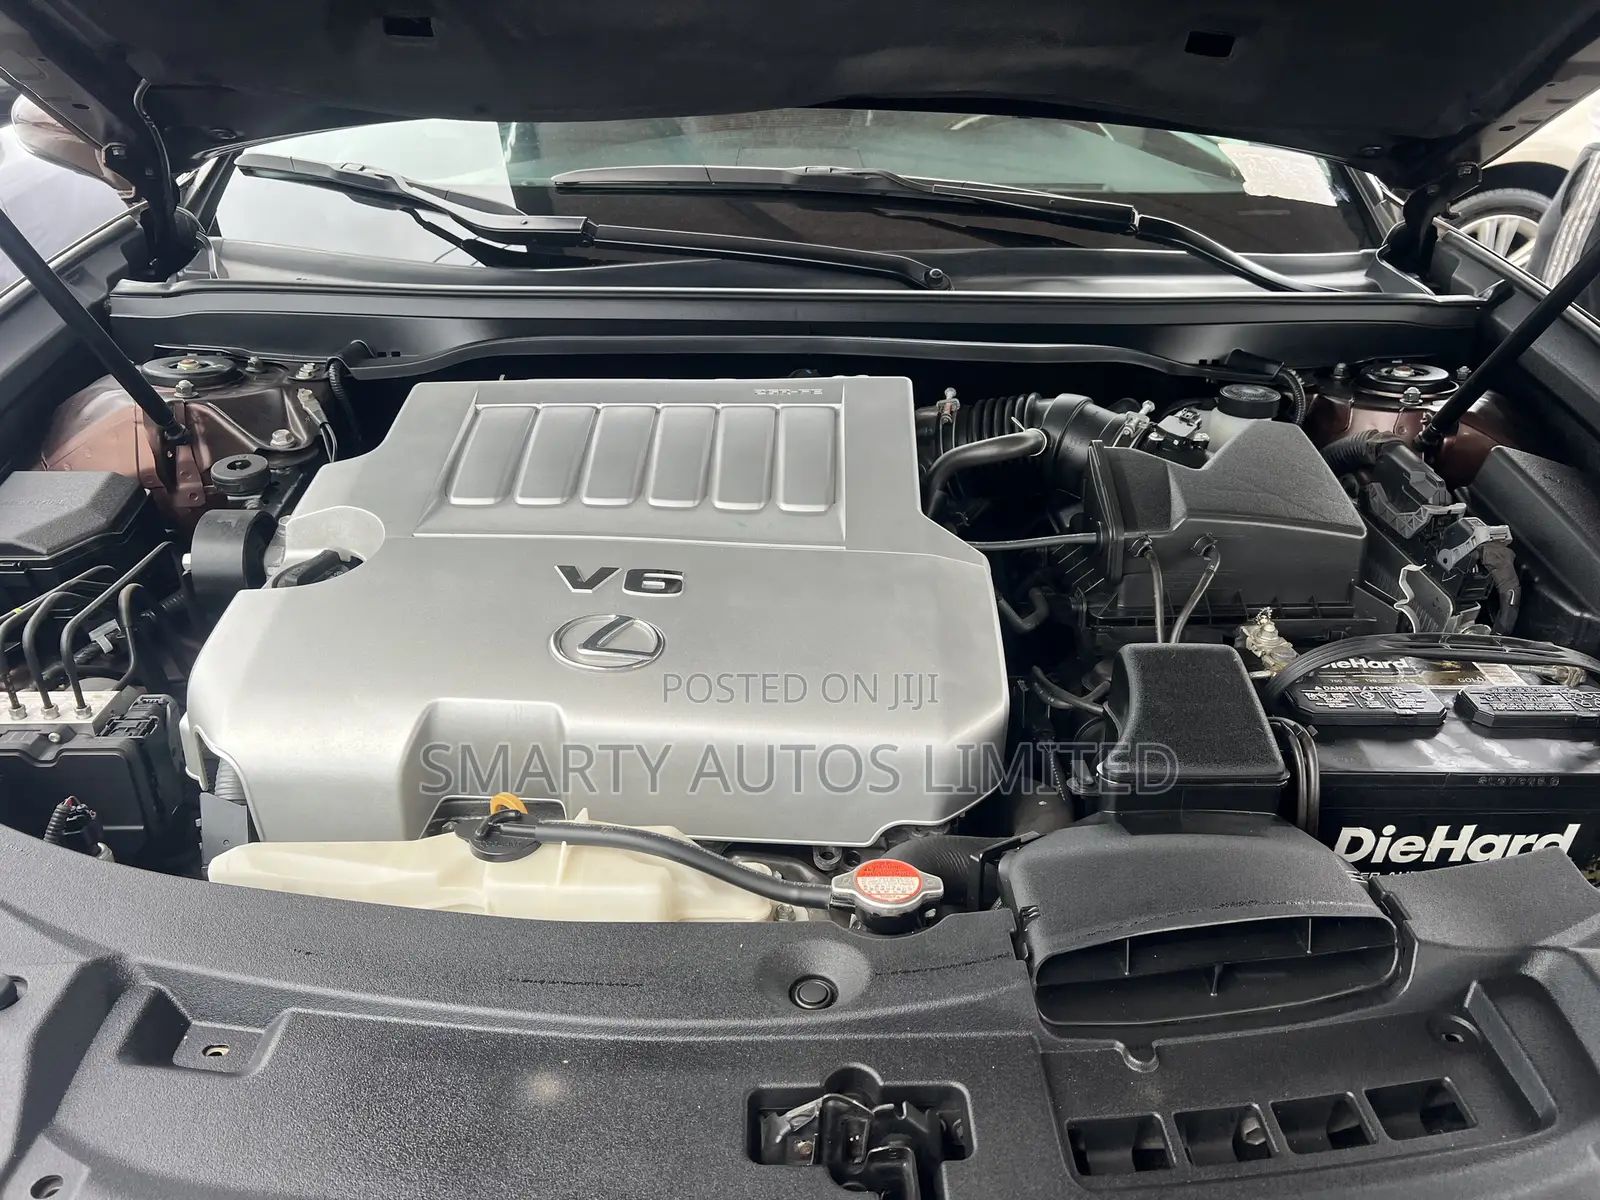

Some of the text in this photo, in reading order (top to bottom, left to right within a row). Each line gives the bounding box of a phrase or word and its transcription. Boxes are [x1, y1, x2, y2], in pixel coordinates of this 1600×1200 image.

[554, 565, 684, 597] V6
[1321, 658, 1409, 669] ieHard
[1334, 823, 1581, 864] DieHard
